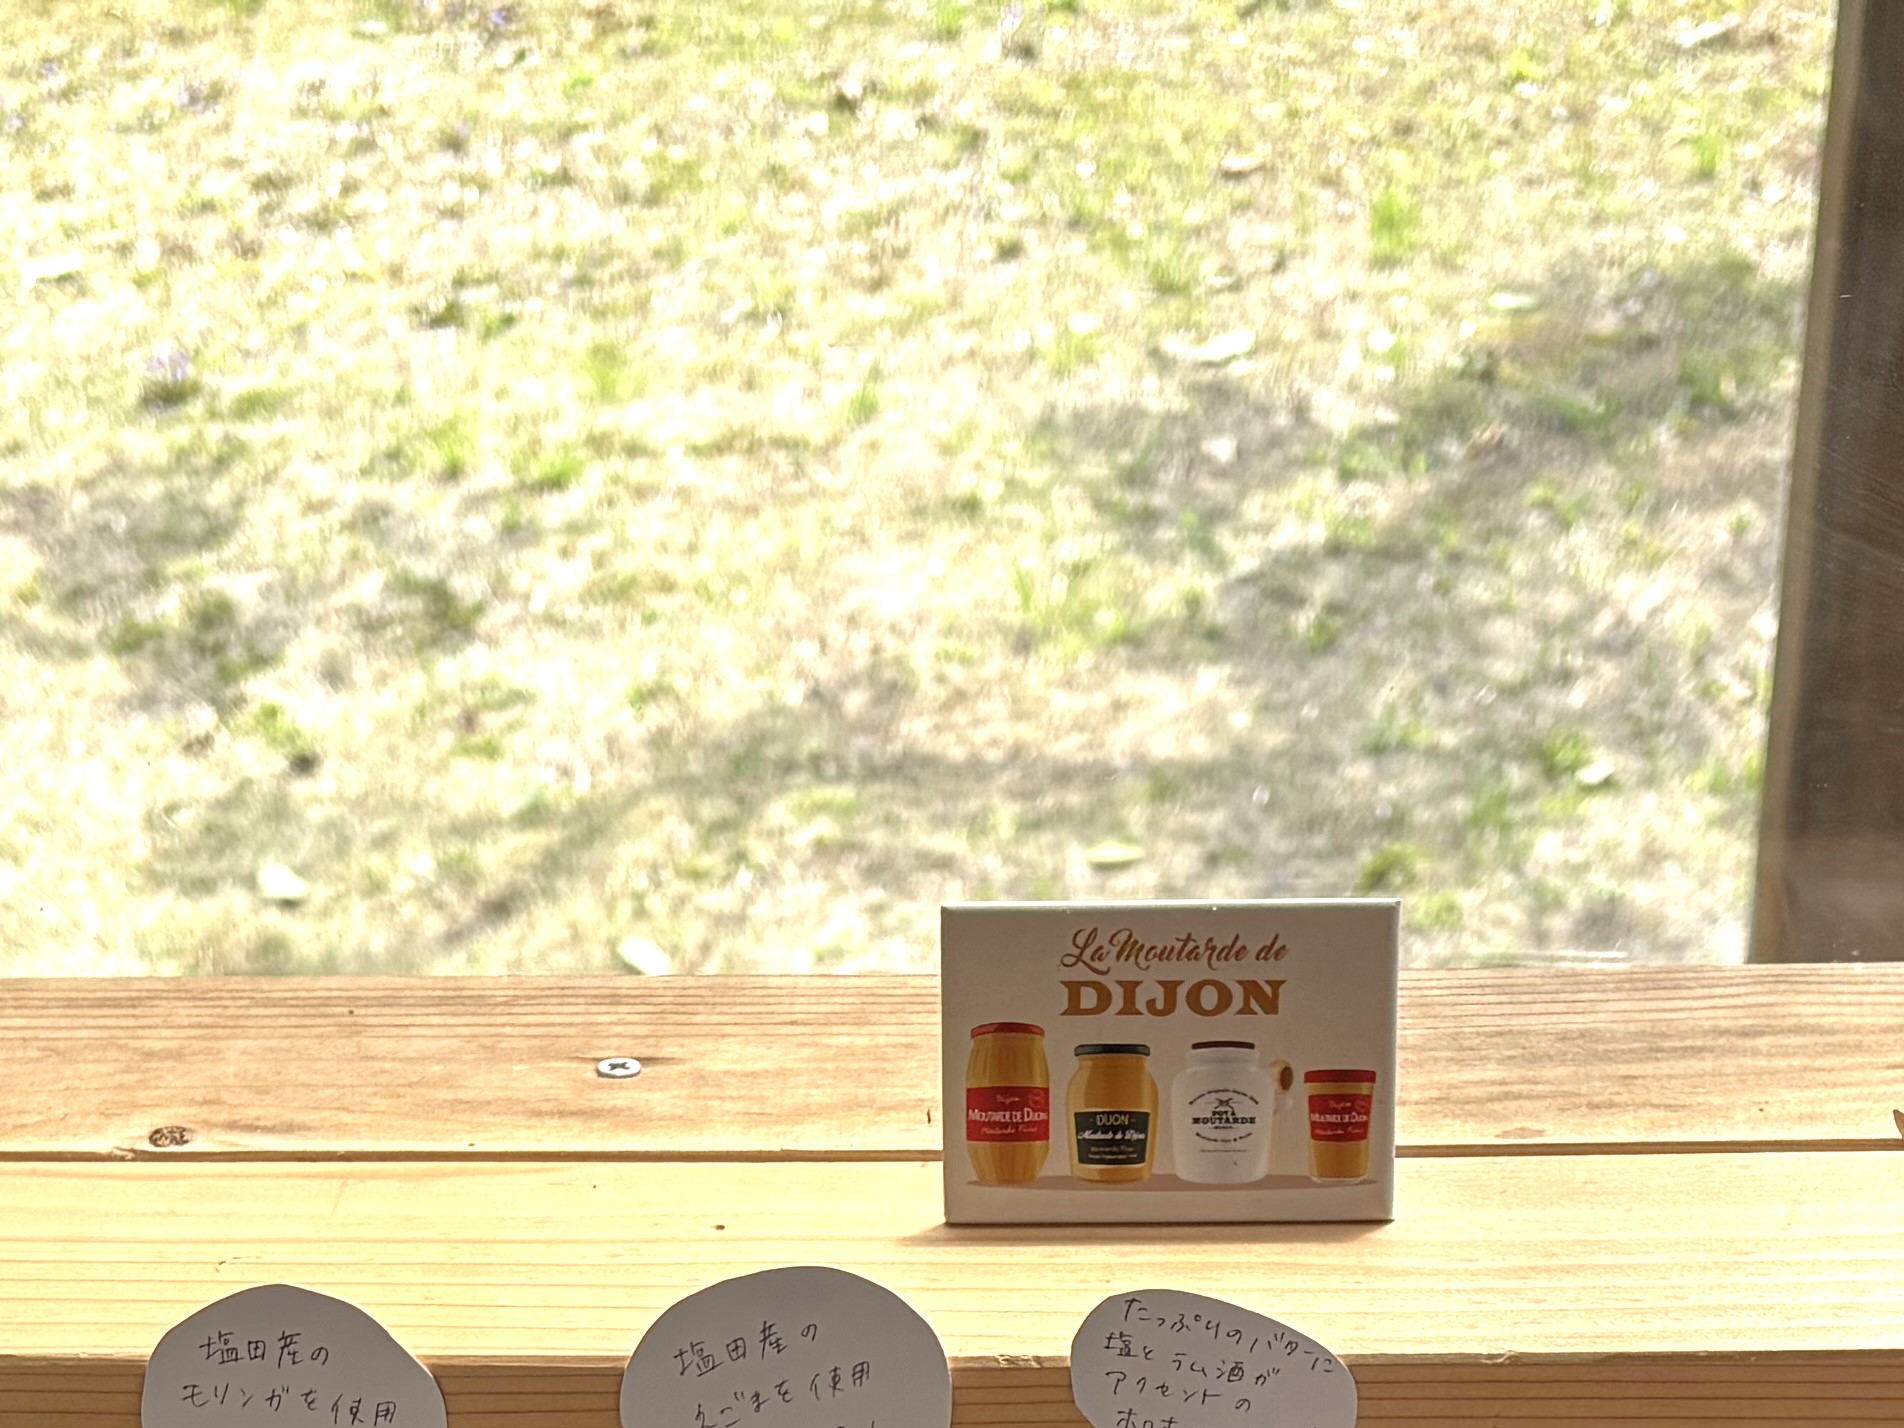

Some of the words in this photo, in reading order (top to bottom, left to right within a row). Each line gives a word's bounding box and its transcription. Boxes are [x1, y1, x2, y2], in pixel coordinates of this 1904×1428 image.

[1060, 927, 1112, 976] La
[1109, 928, 1249, 972] Moutarde
[1255, 933, 1290, 963] de
[1059, 979, 1287, 1017] DIJON
[1096, 1114, 1128, 1126] DIJON
[1192, 1116, 1256, 1125] MOUTARDE
[198, 1330, 329, 1368] 塩田産の
[673, 1320, 818, 1377] 塩田産の
[1124, 1298, 1335, 1373] たっぷりのバターに
[182, 1382, 396, 1426] モリンガを使用
[1104, 1370, 1251, 1412] アクセントの
